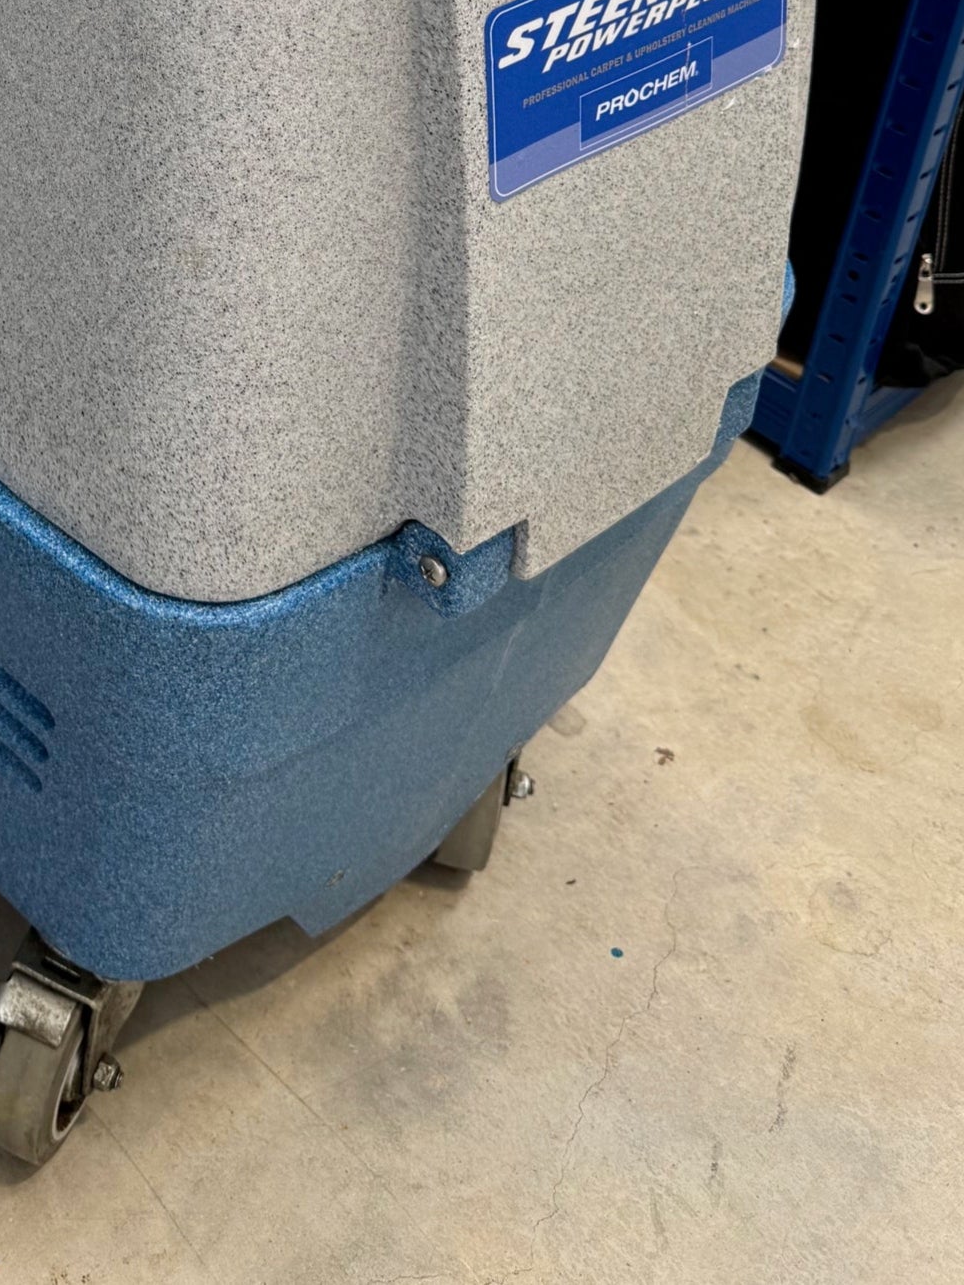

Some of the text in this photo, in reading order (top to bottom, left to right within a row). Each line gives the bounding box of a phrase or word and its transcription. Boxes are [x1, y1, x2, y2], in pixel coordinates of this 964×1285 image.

[522, 70, 589, 109] PROFESSIONAL
[590, 56, 624, 77] CARPET
[626, 51, 634, 62] &
[635, 27, 687, 58] UPHOLSTERY
[687, 9, 726, 34] CLEANING
